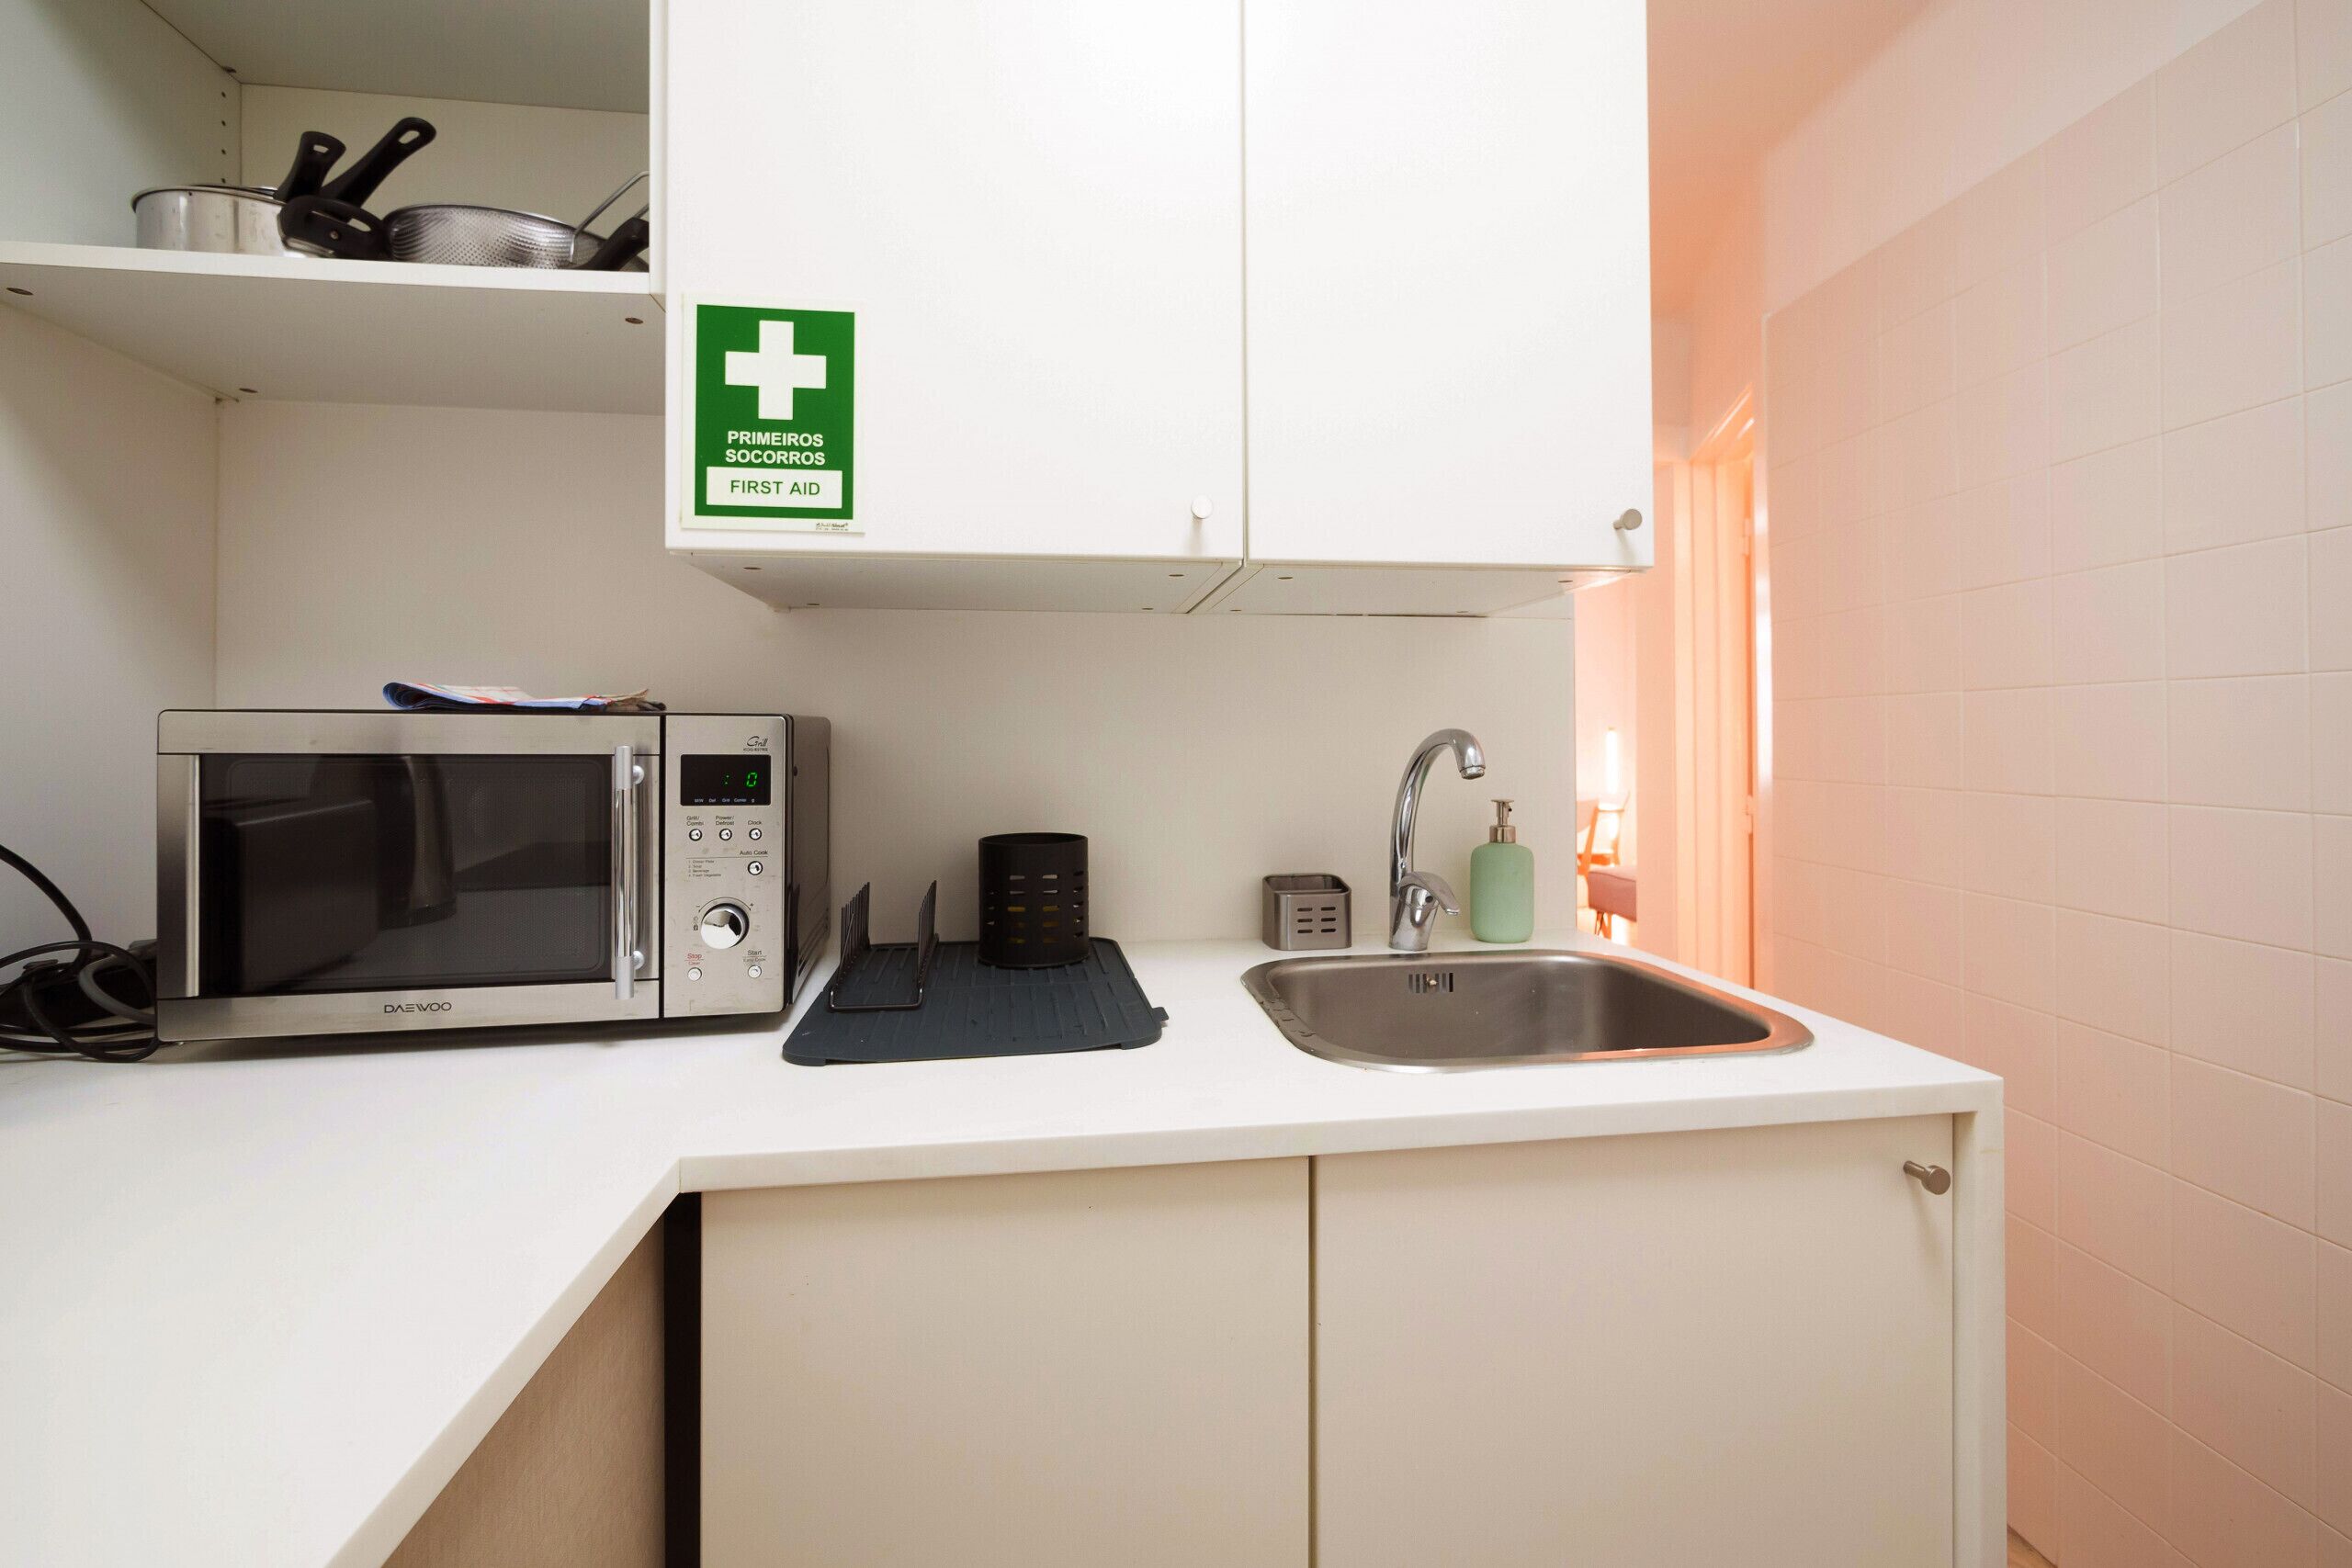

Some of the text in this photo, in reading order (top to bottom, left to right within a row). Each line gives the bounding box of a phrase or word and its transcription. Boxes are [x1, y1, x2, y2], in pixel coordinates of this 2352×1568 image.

[728, 430, 824, 447] PRIMEIROS
[725, 448, 826, 466] SOCORROS
[730, 479, 820, 496] FIRST AID
[746, 736, 768, 747] Grill
[746, 772, 758, 787] 0
[384, 1002, 452, 1013] DAEWOO
